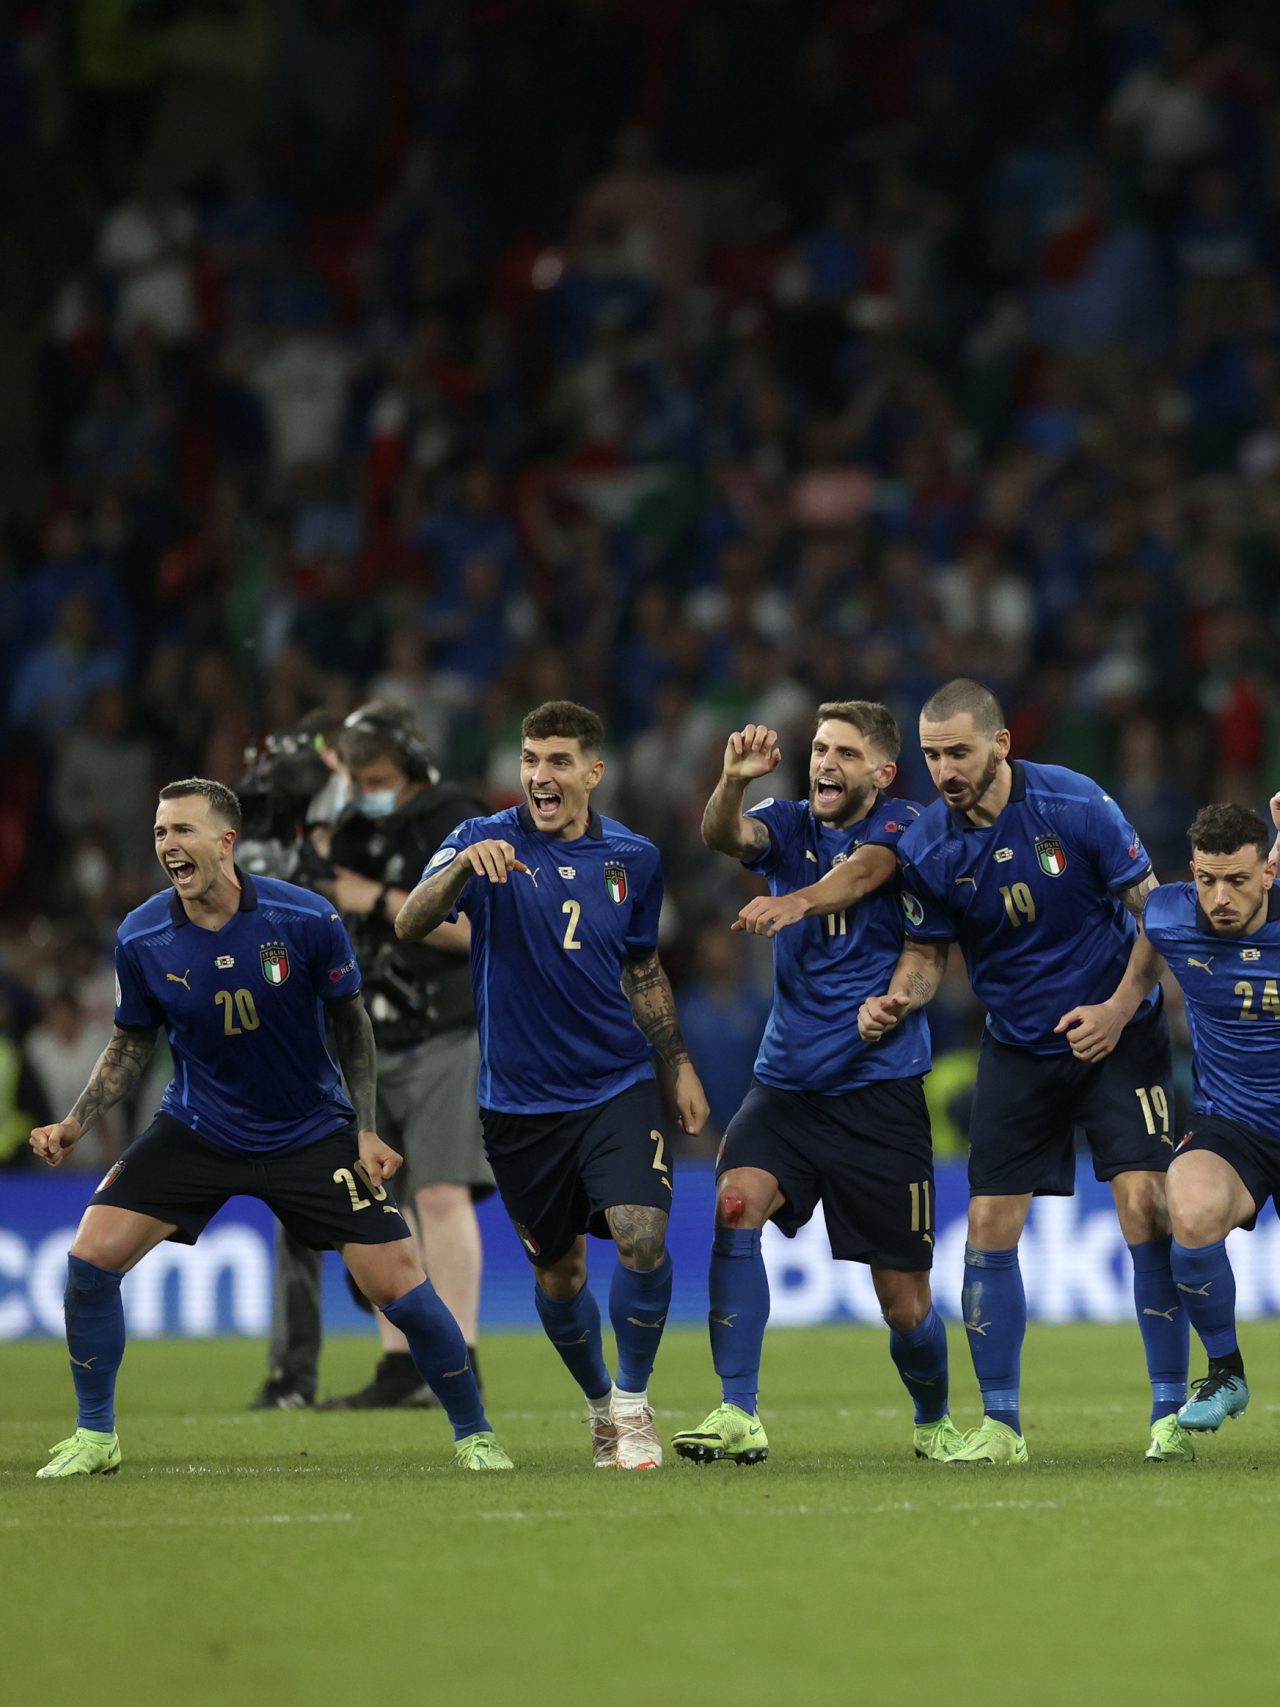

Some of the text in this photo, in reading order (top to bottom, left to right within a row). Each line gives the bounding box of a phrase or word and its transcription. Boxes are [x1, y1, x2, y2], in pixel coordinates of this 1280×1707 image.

[562, 899, 582, 950] 2
[999, 882, 1036, 928] 19
[262, 950, 286, 960] ITALIA
[214, 988, 261, 1036] 20
[1135, 1085, 1169, 1135] 19
[650, 1129, 668, 1172] 2
[909, 1180, 931, 1231] 11
